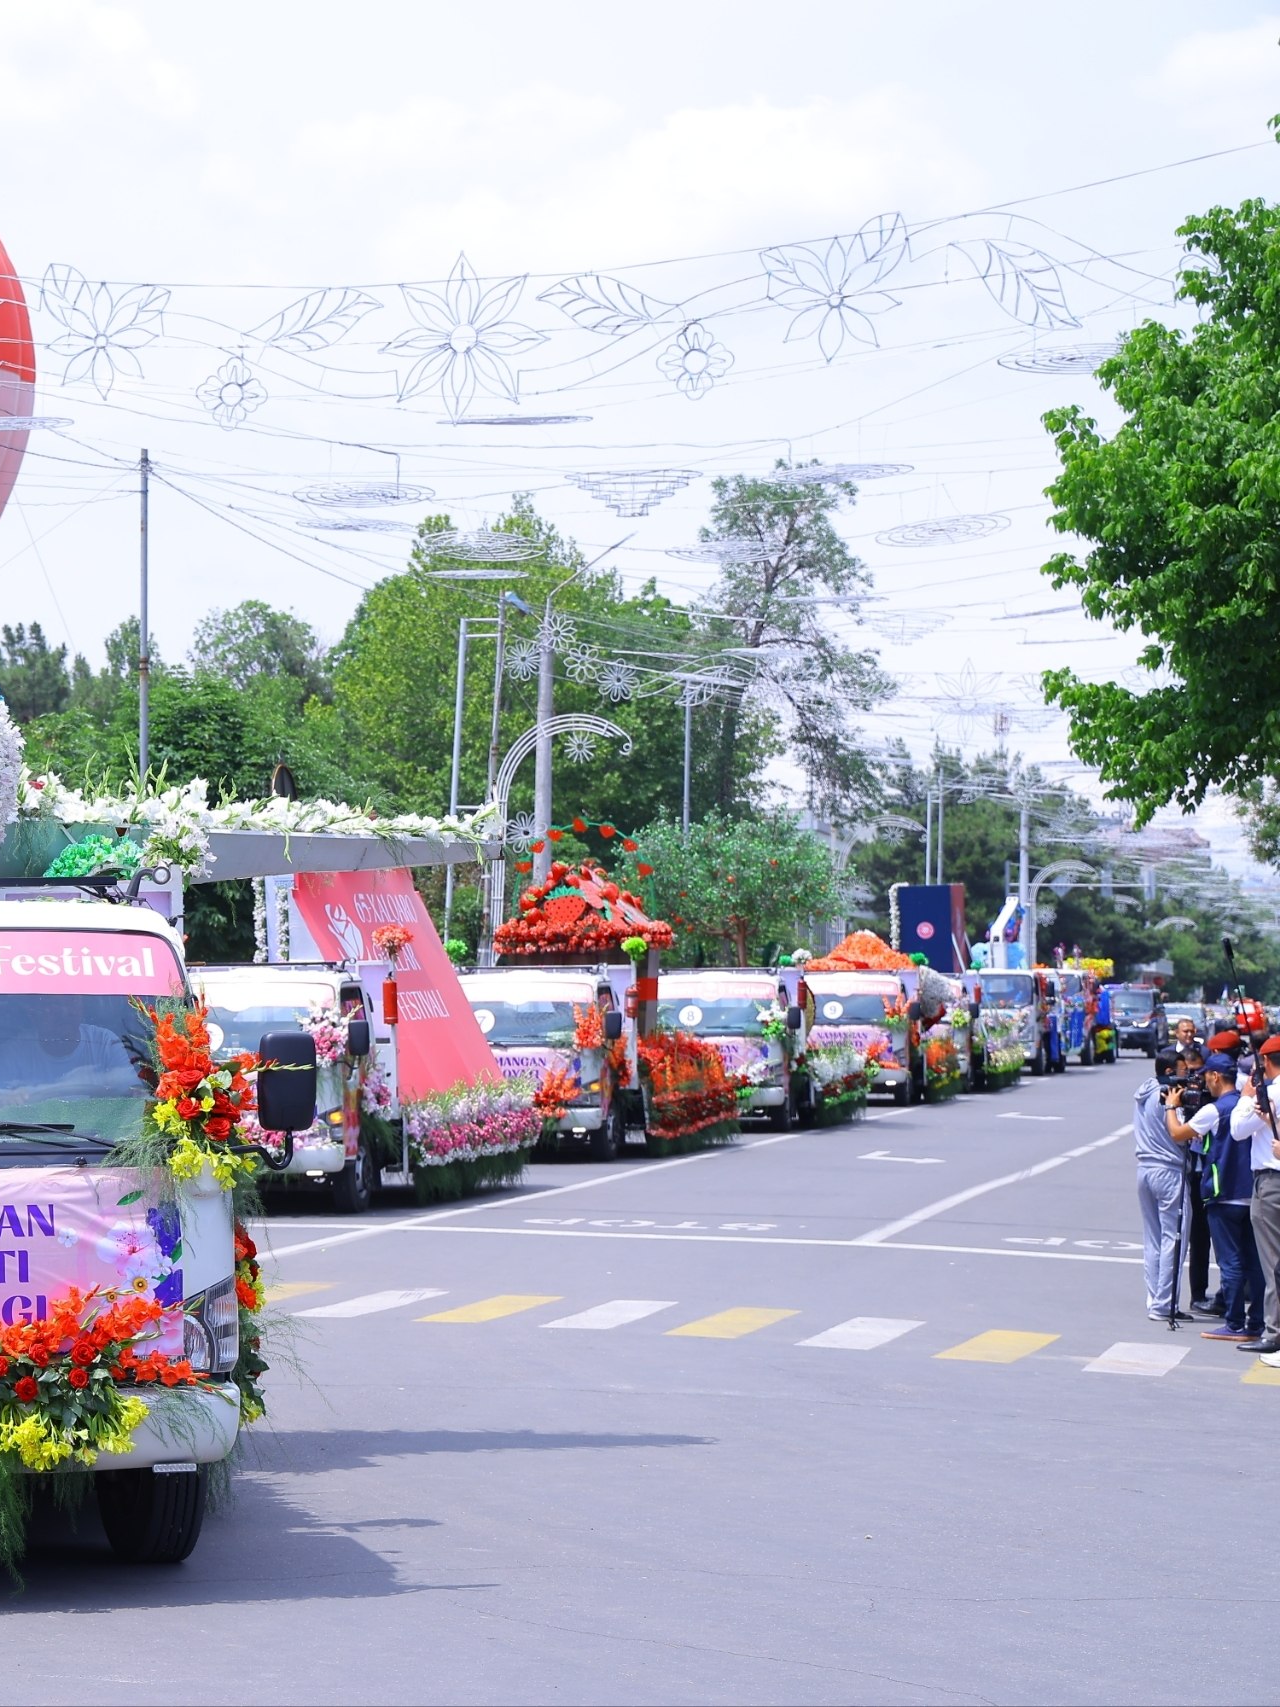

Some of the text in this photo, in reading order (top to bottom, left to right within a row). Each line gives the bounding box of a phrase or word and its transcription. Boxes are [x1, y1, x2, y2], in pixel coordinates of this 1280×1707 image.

[686, 1010, 695, 1022] 8
[829, 1005, 837, 1016] 9
[494, 1056, 547, 1067] MANGAN
